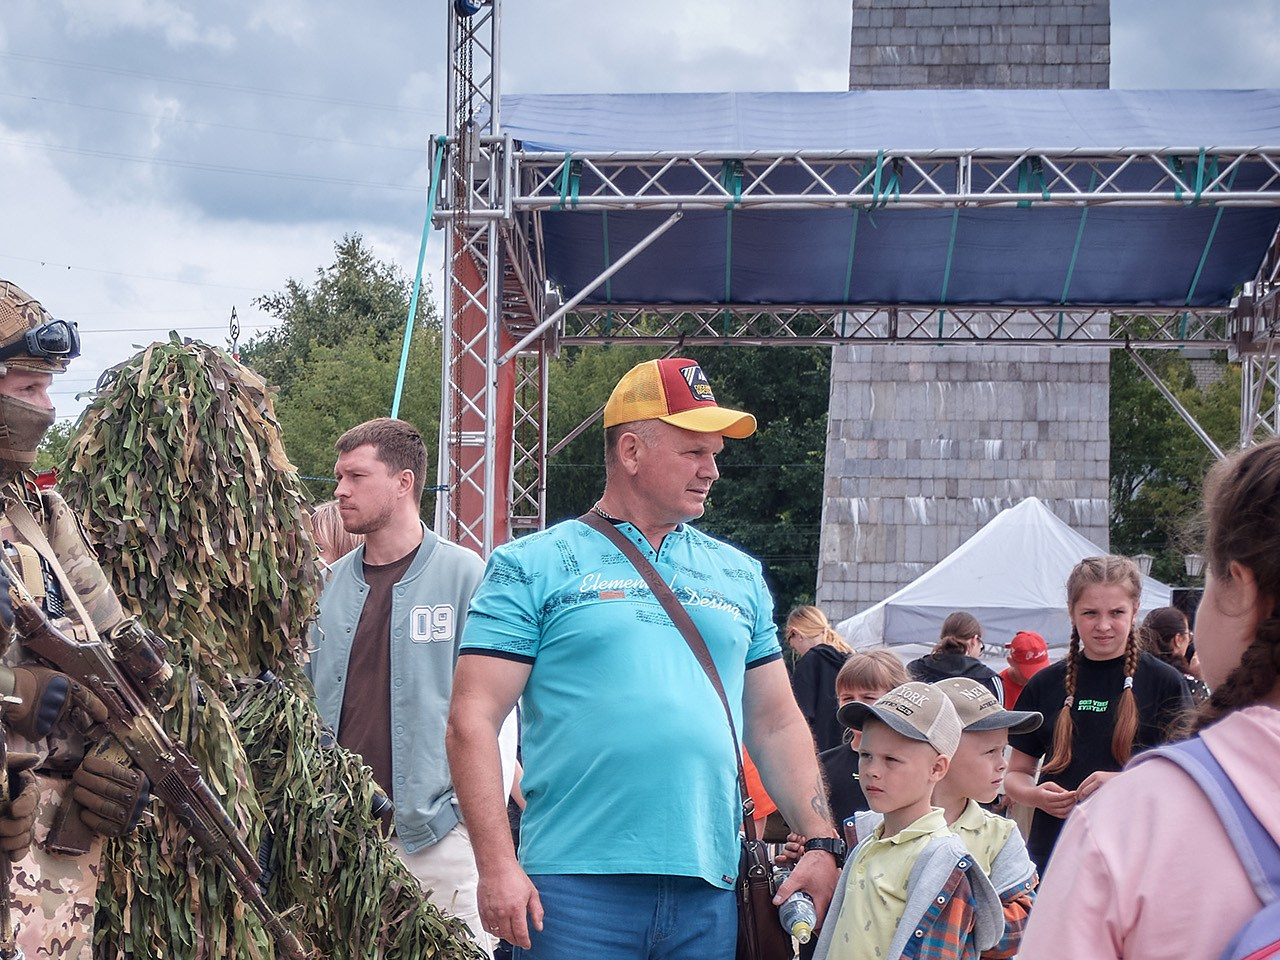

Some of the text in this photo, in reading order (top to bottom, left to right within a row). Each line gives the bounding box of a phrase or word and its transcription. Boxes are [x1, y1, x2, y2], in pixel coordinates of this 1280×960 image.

[580, 573, 677, 592] Elemenl
[410, 604, 455, 644] 09
[897, 686, 930, 708] YORK
